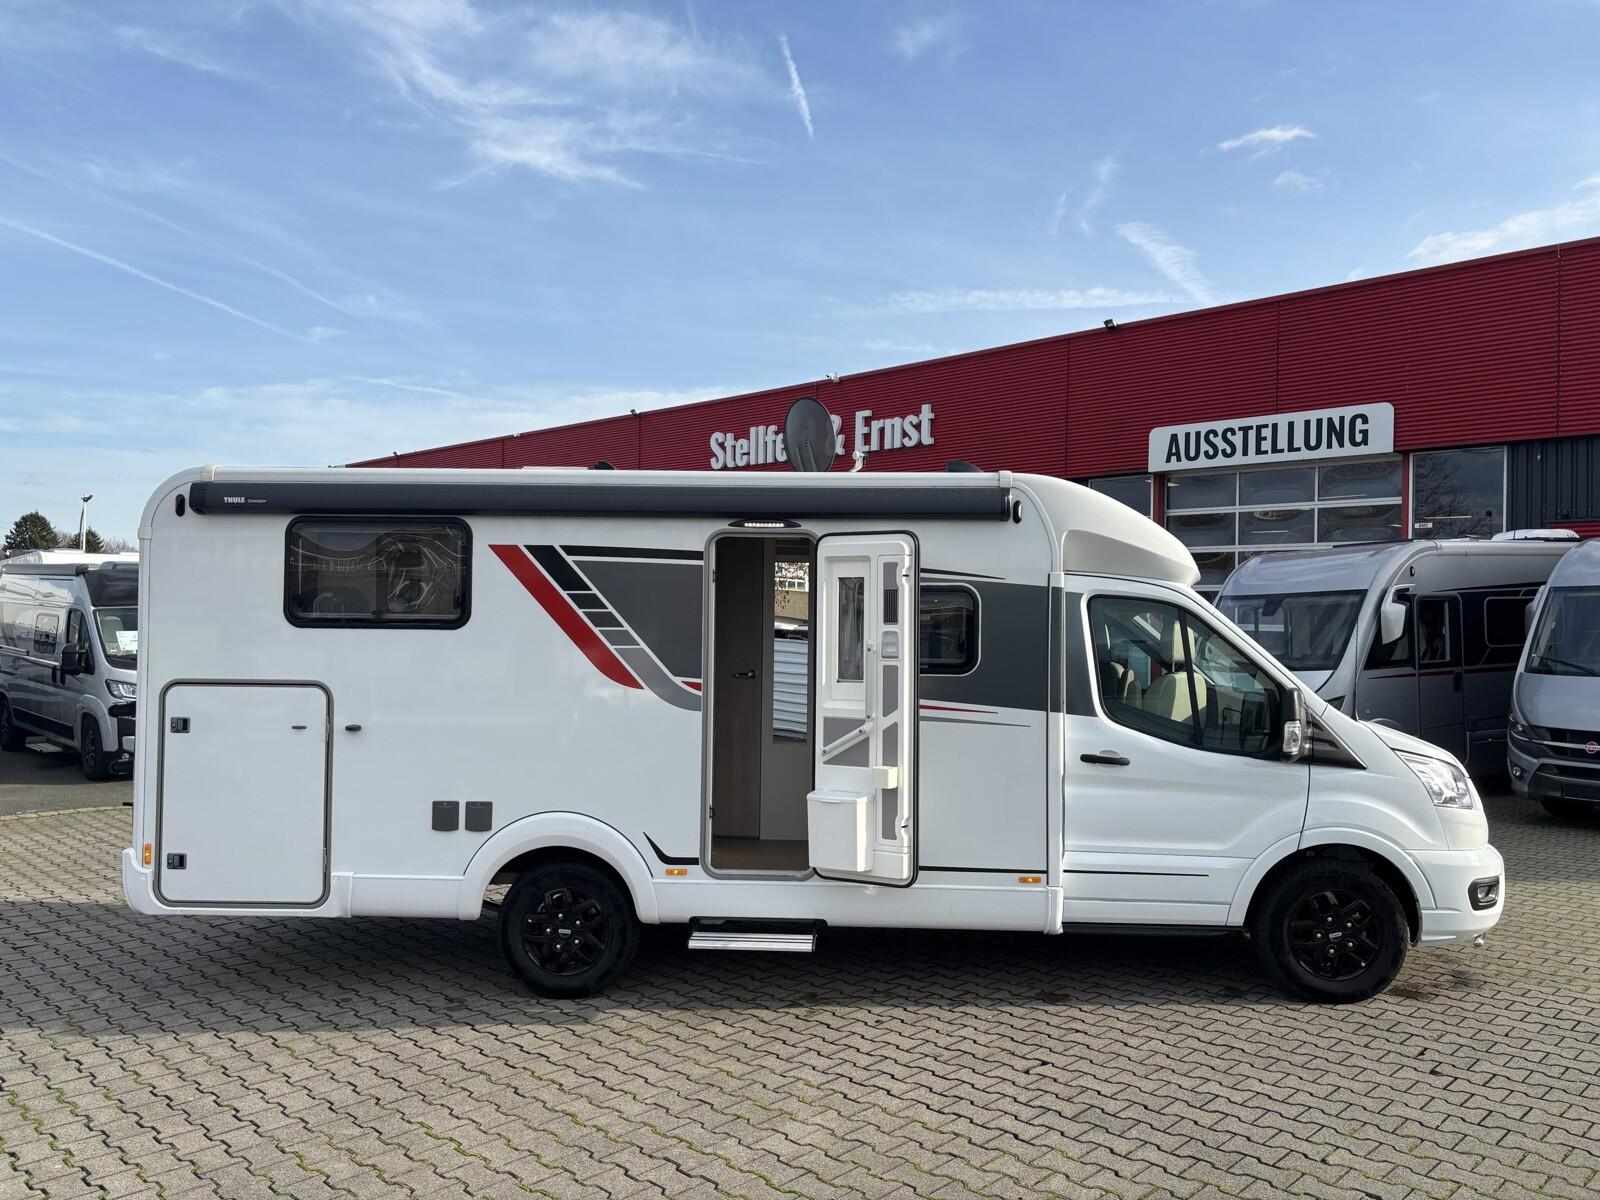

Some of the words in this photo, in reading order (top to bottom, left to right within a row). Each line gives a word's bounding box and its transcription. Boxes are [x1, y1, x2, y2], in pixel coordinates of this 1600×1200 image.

[710, 425, 788, 470] Stellfe
[854, 403, 935, 453] Ernst
[1165, 413, 1370, 463] AUSSTELLUNG
[223, 496, 246, 504] THULE
